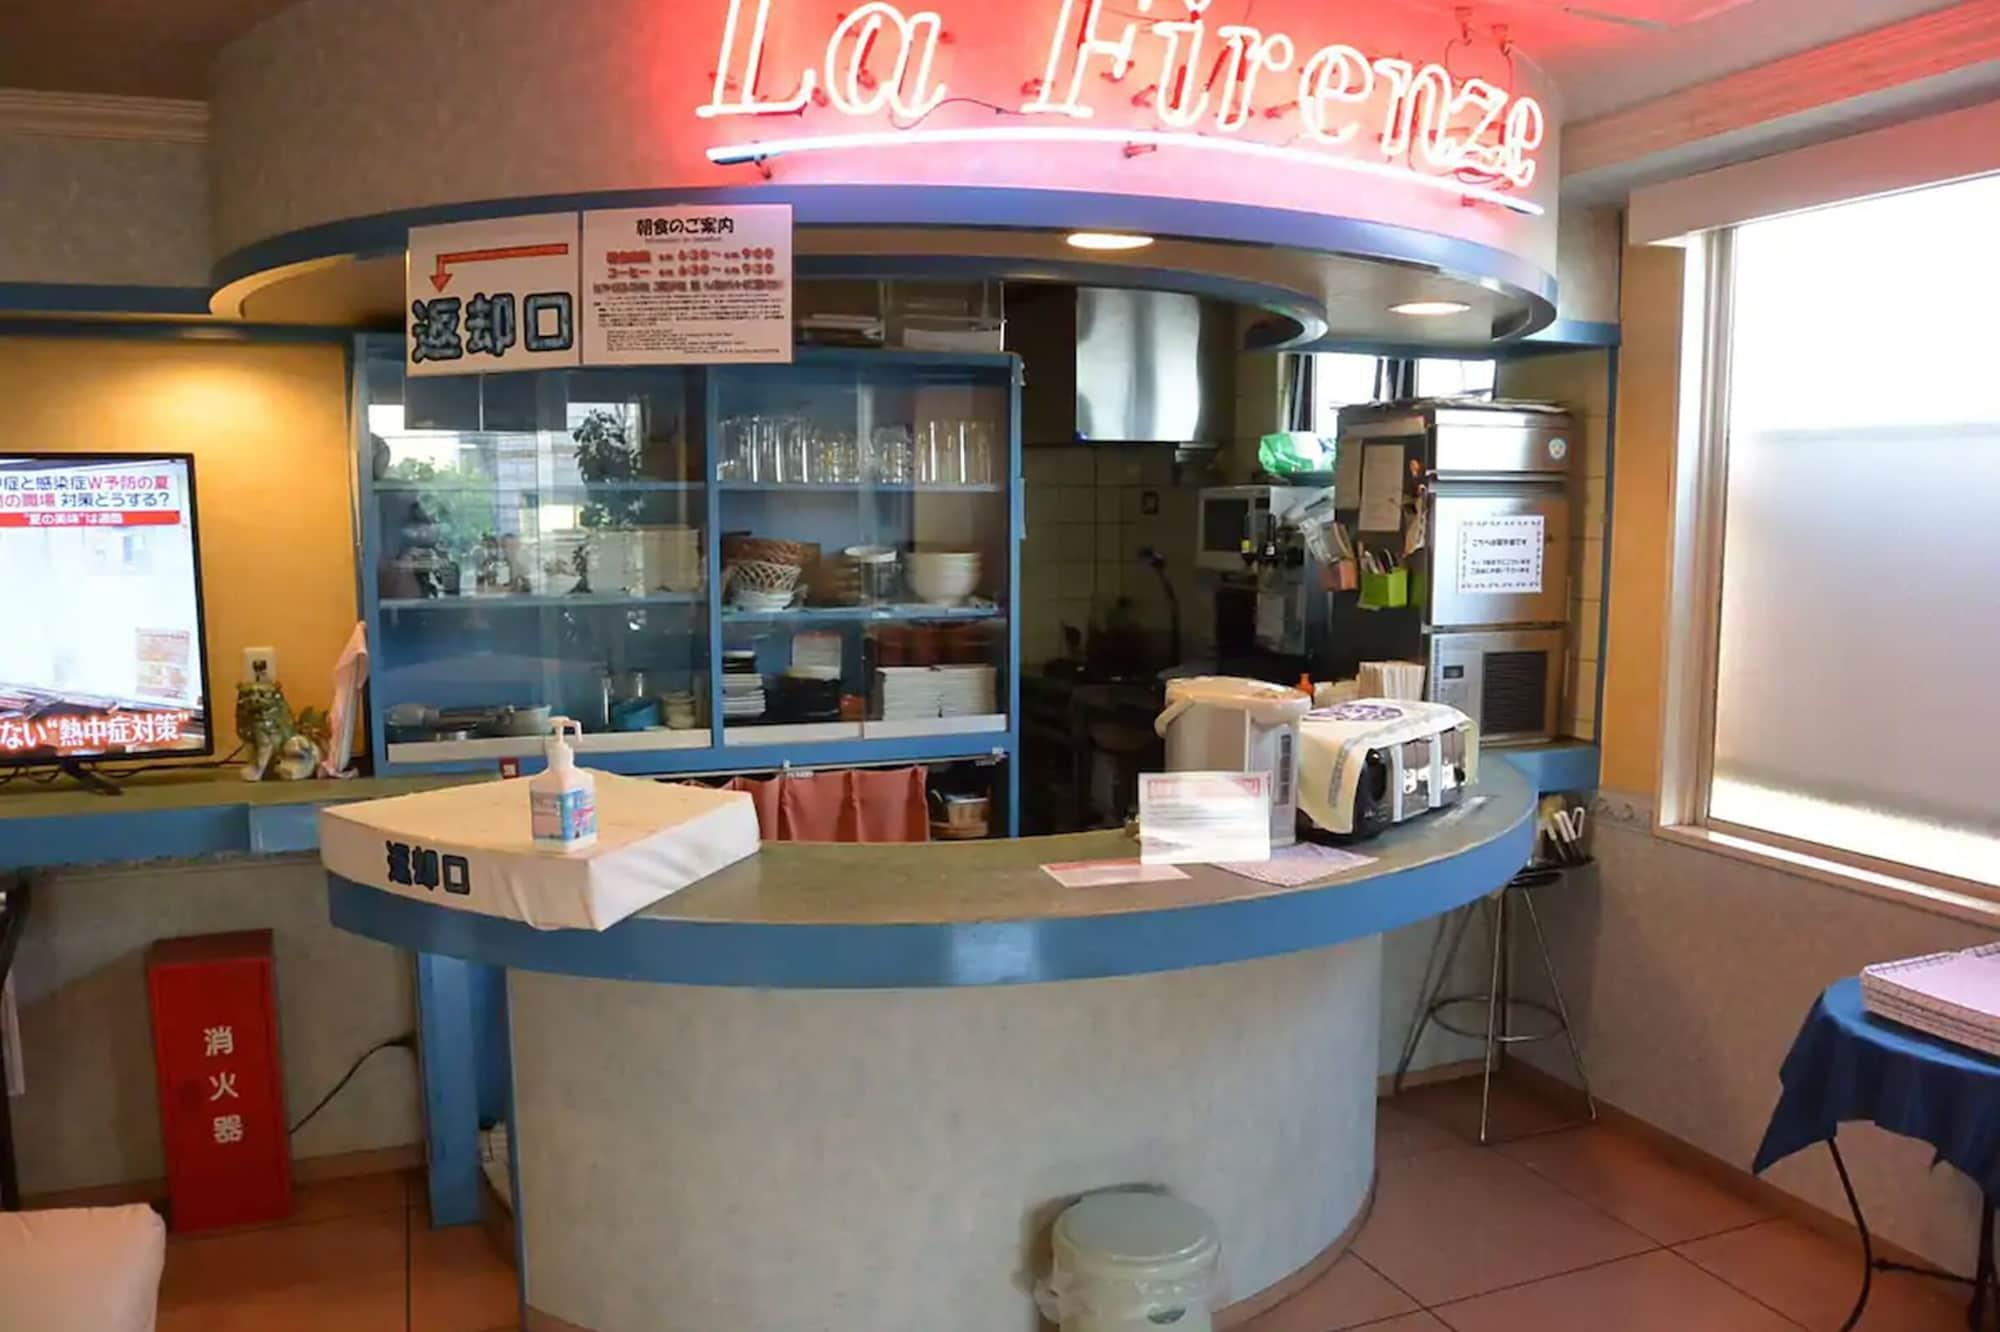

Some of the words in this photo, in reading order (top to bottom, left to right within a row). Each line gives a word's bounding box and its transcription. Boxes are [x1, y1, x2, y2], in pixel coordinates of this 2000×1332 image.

[695, 0, 948, 119] La
[1021, 0, 1544, 187] Firenze
[636, 216, 735, 236] 朝食のご案内
[411, 292, 574, 364] 返却口
[0, 475, 169, 491] 症と感染症W予防の夏
[203, 1025, 244, 1144] 消火器
